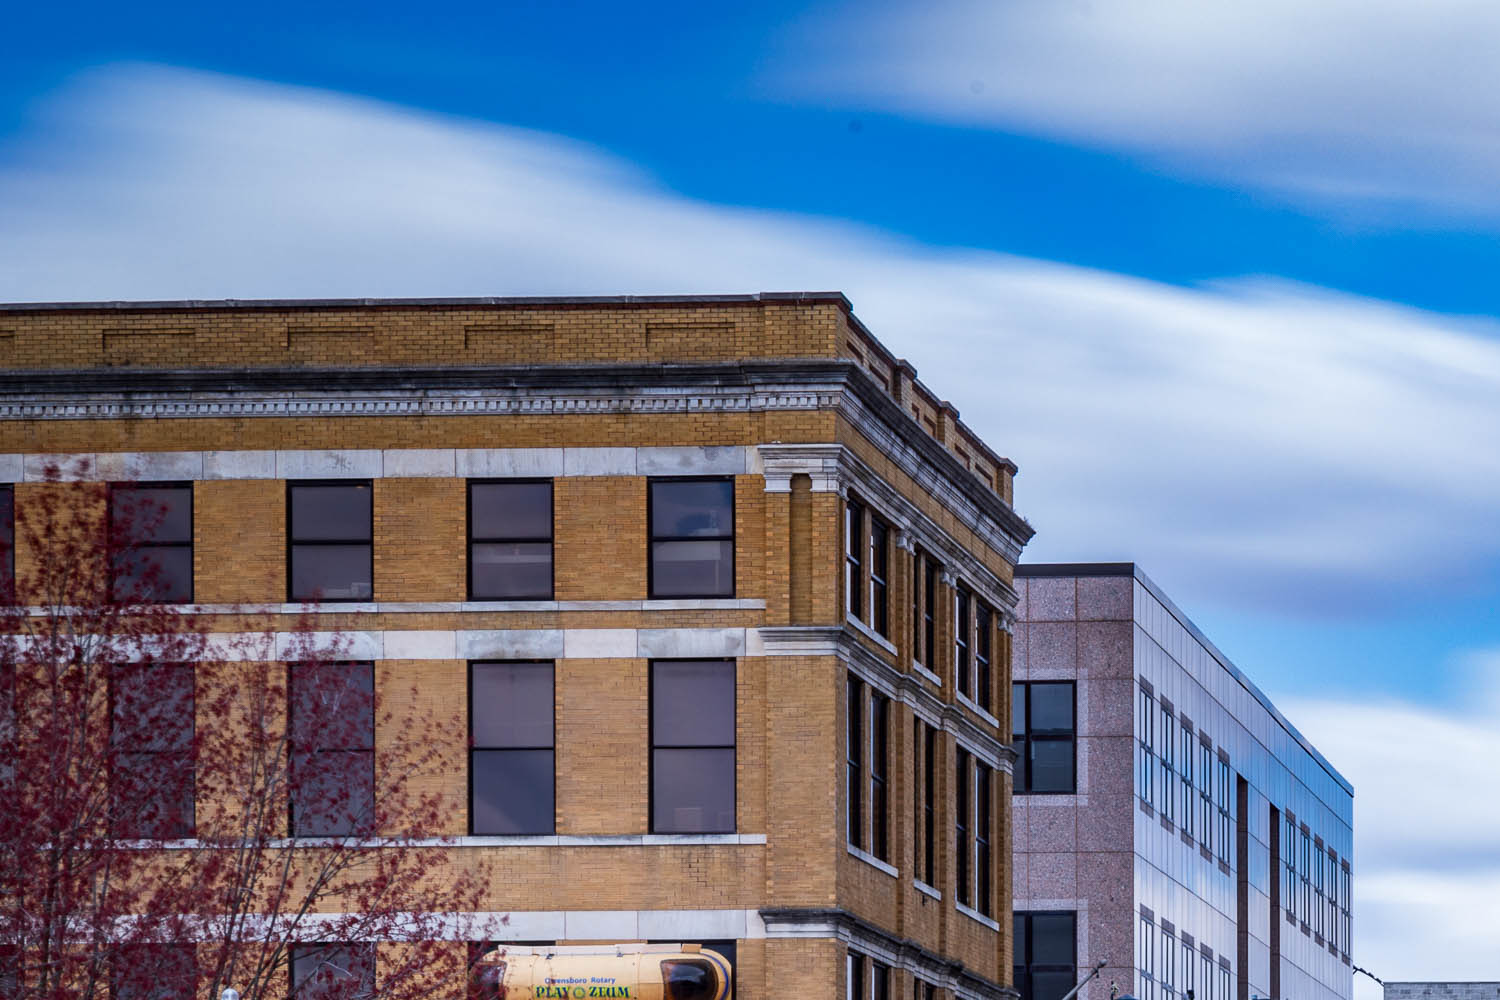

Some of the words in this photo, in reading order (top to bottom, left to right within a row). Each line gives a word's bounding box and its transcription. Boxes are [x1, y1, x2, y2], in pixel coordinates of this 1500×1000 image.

[544, 976, 587, 985] Oensboro
[591, 976, 616, 985] Rotary
[536, 986, 569, 999] PLAY
